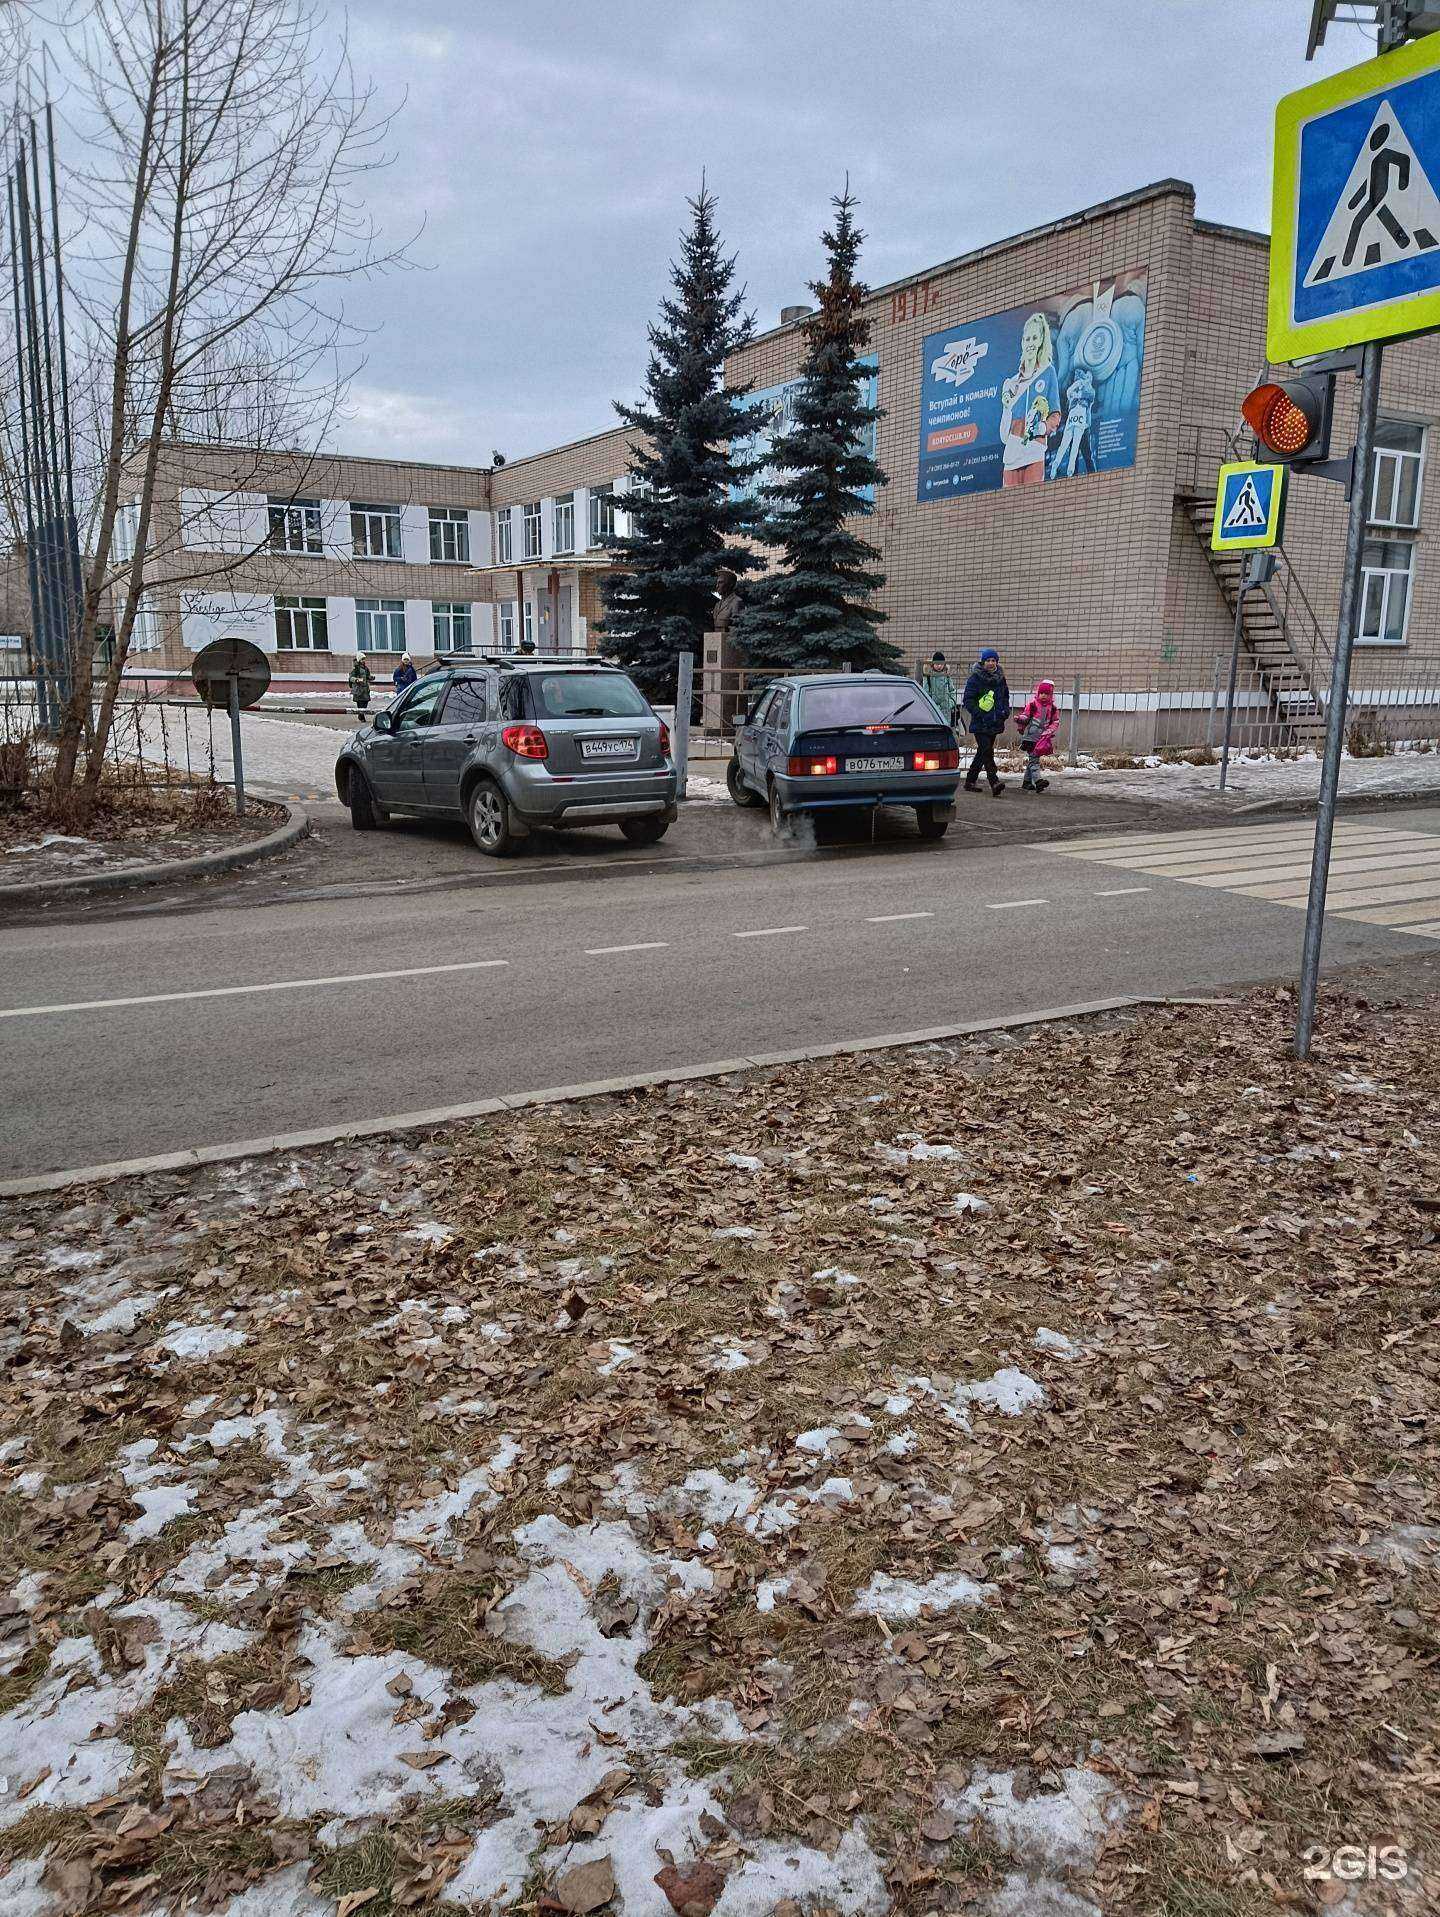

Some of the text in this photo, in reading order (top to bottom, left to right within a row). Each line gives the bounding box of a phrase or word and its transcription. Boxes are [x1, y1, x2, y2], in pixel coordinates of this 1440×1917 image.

[929, 386, 998, 411] Вступай в команду
[928, 406, 971, 426] чемпионов!
